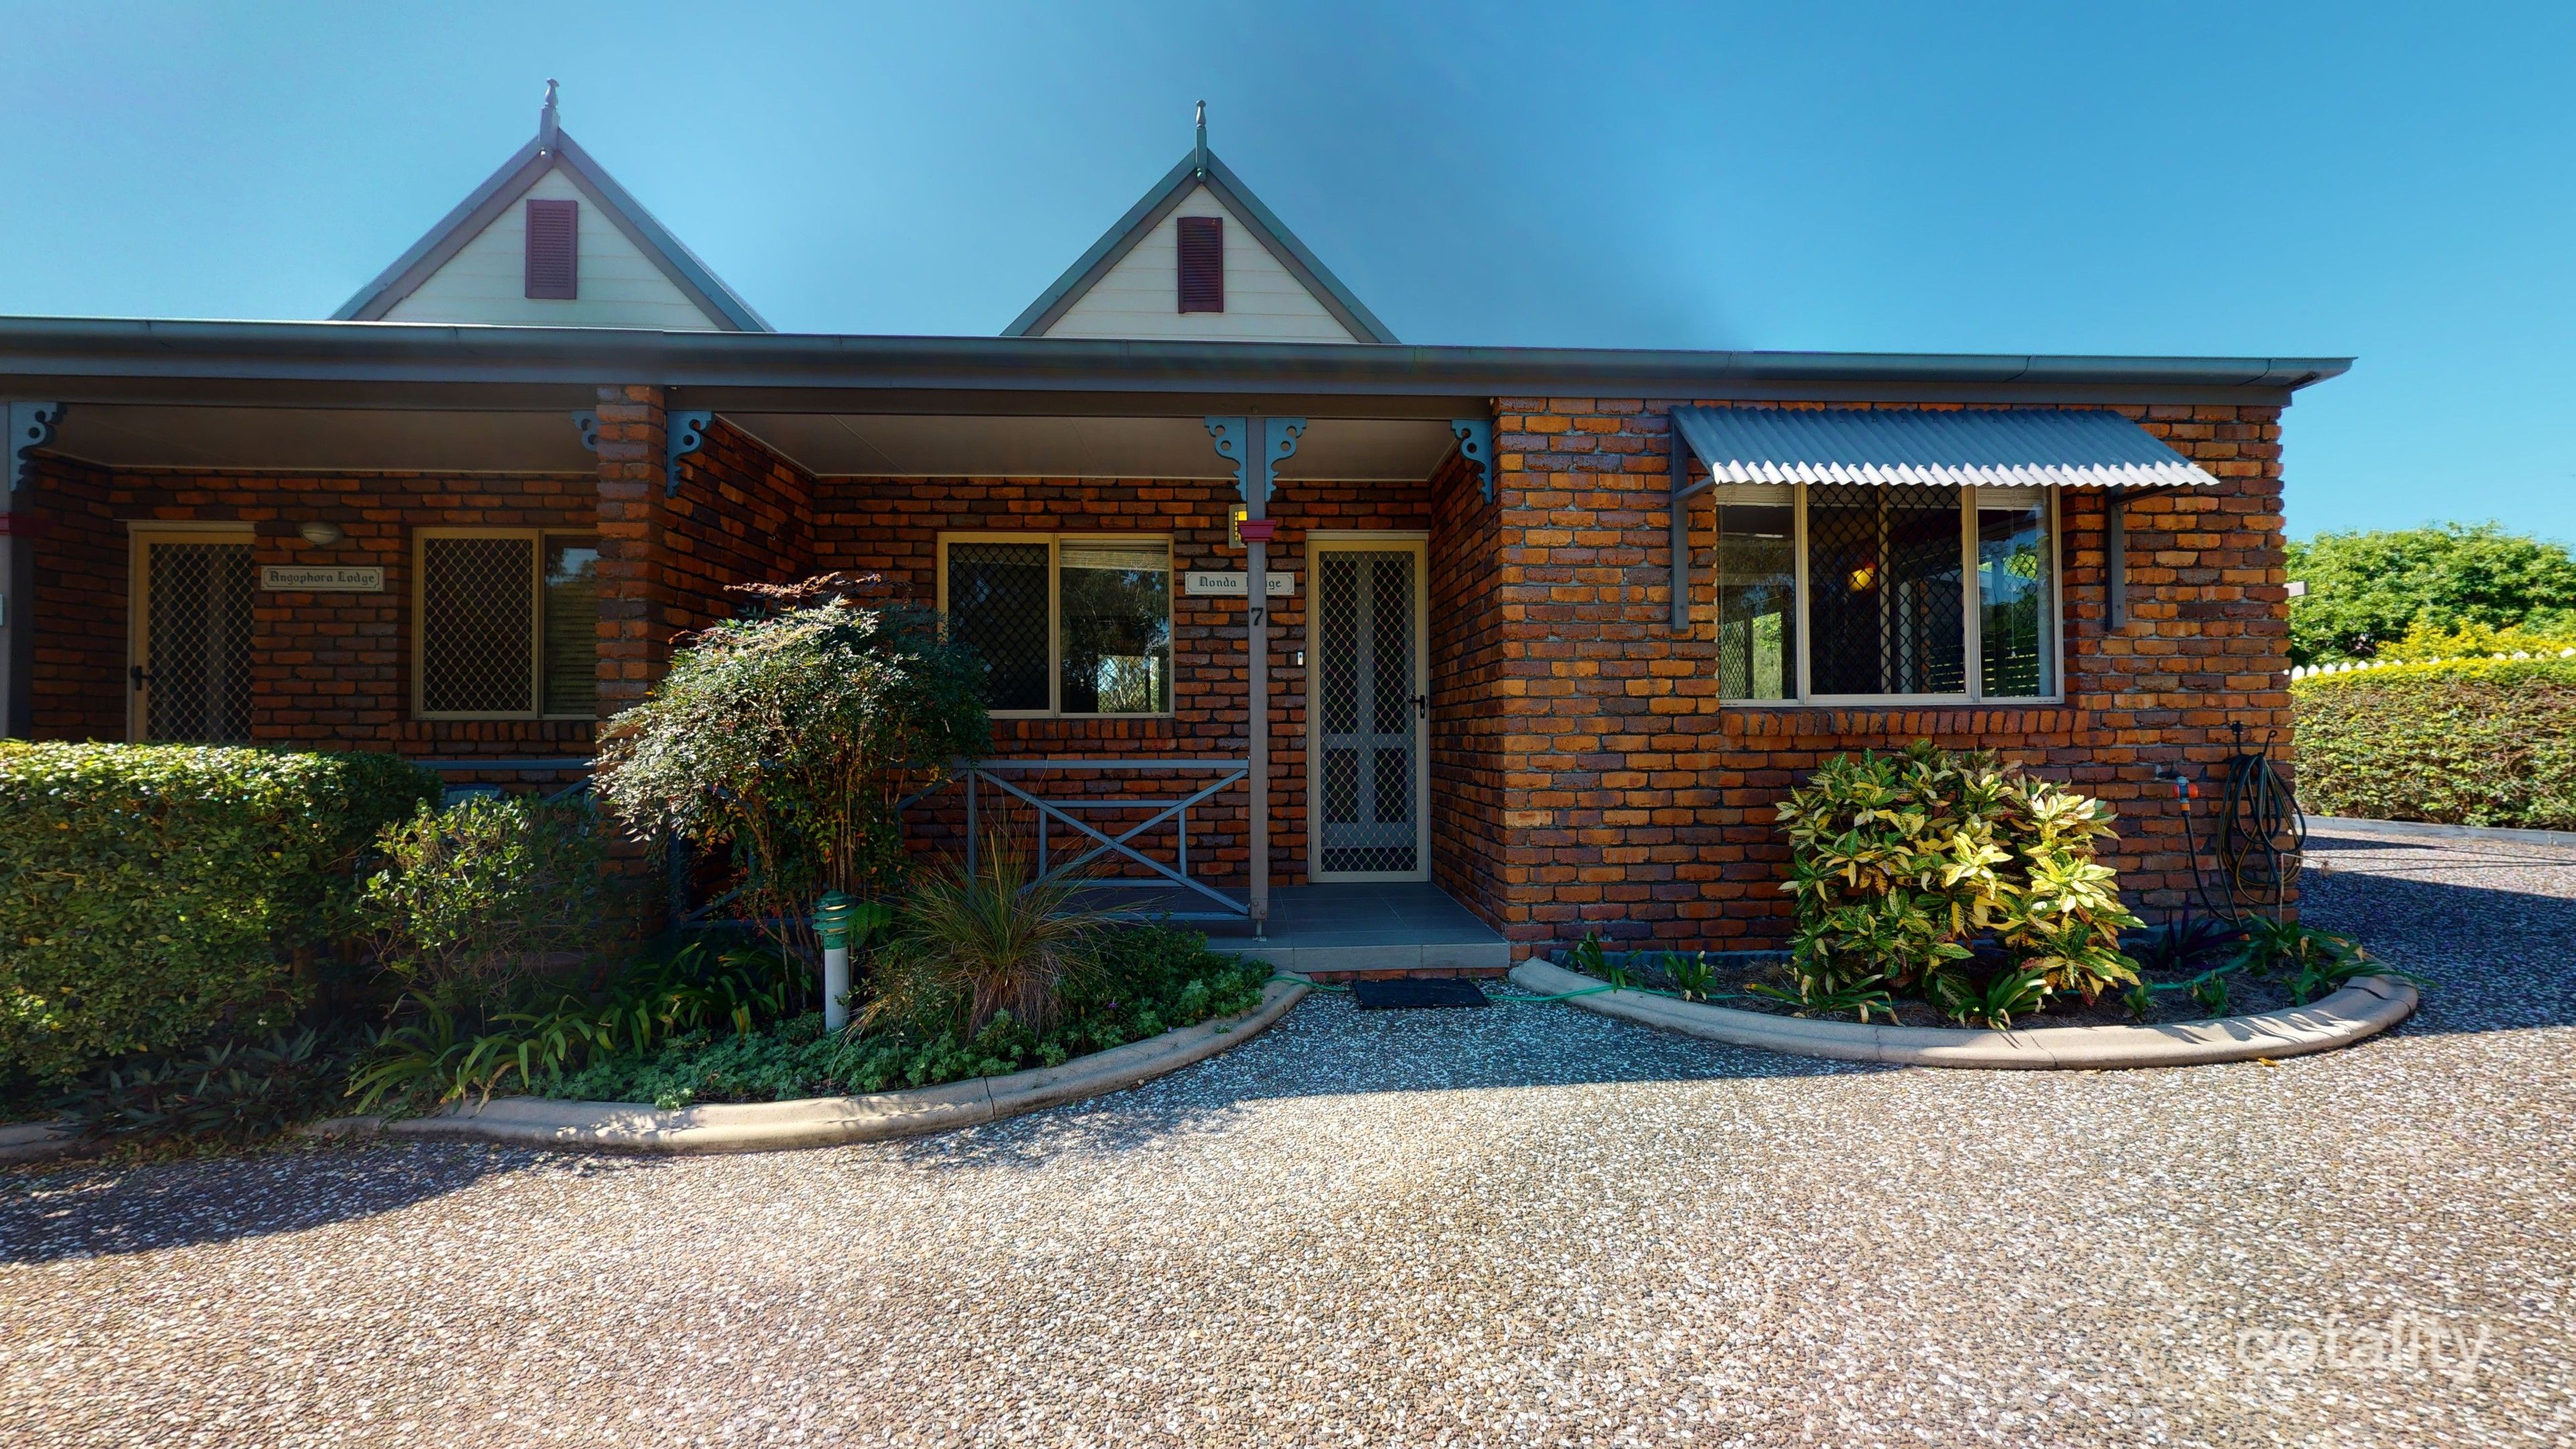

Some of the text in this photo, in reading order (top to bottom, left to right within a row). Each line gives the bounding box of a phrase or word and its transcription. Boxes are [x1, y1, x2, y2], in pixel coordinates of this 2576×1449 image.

[269, 571, 375, 585] Angophora Lodge
[1199, 576, 1236, 587] Nonda
[1251, 607, 1264, 626] 7
